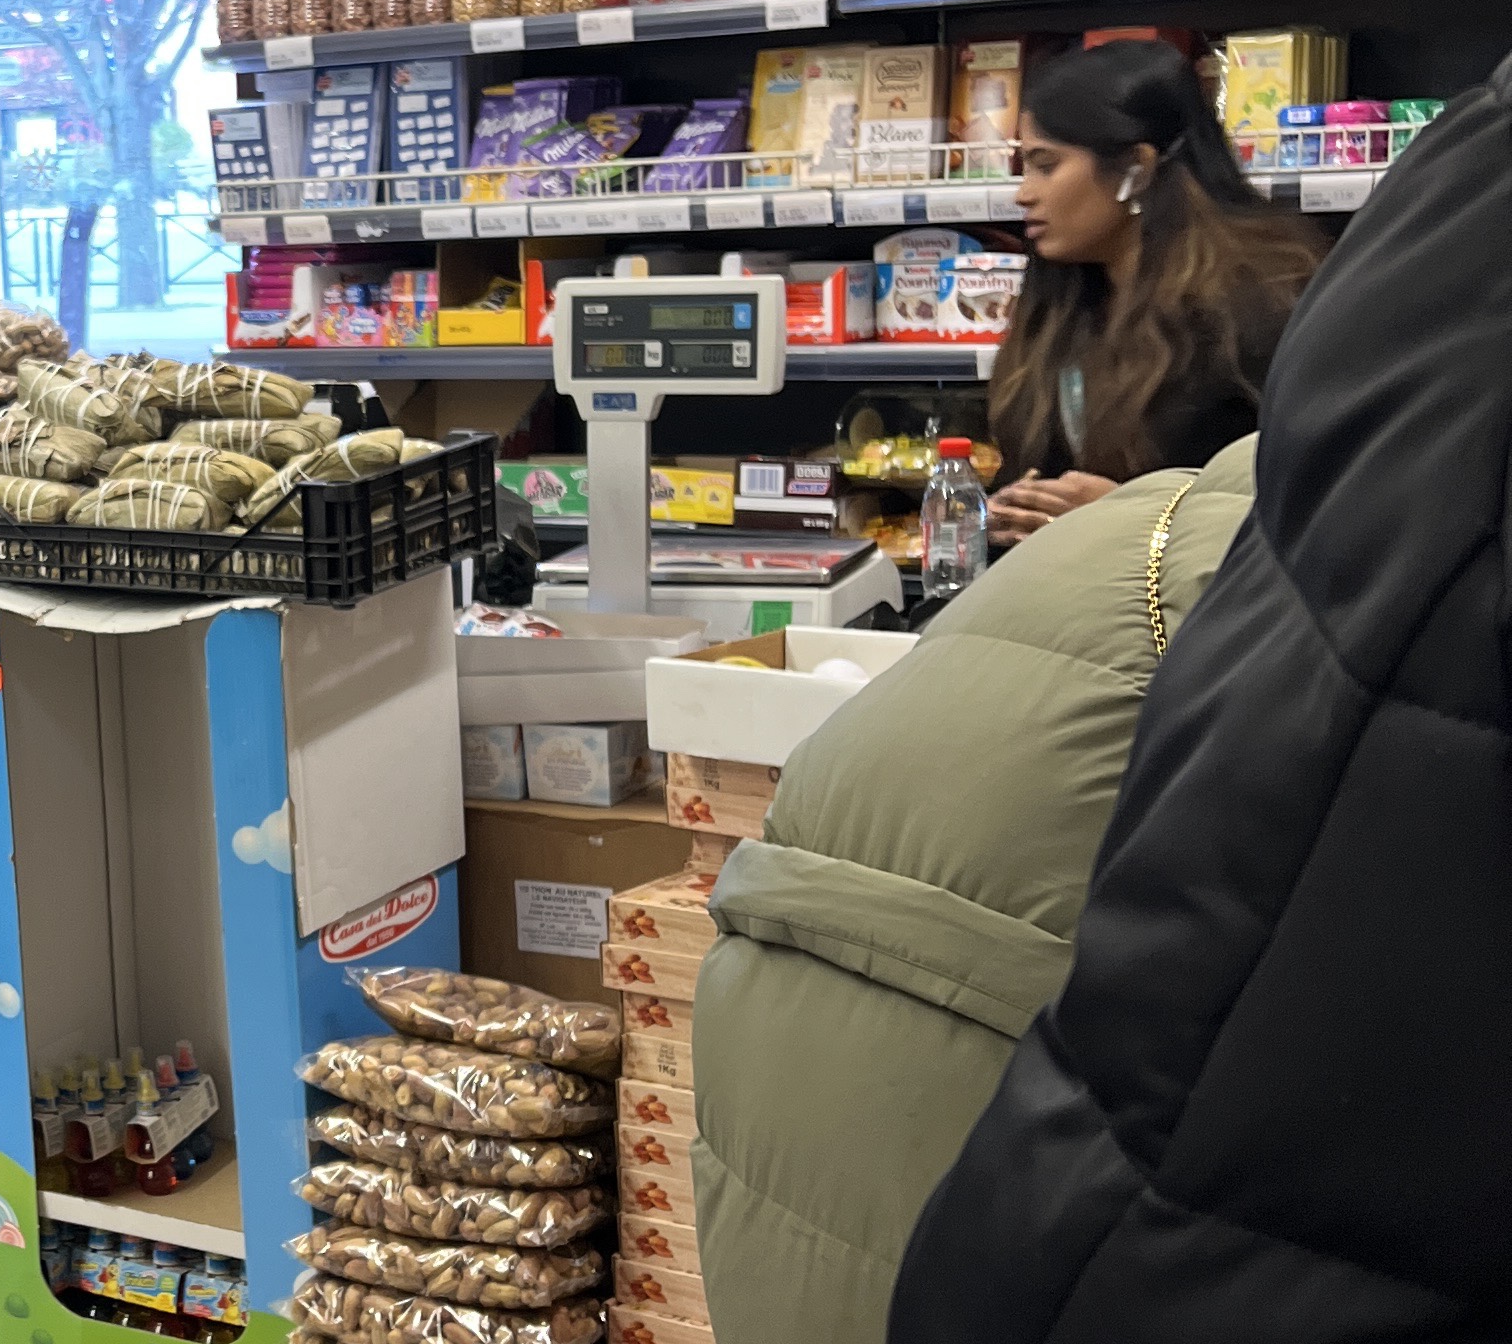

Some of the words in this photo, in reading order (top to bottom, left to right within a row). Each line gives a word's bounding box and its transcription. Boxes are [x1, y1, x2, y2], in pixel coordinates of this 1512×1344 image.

[542, 133, 587, 163] Milka
[957, 277, 1014, 293] Country
[384, 893, 429, 920] Dolce
[657, 1064, 677, 1077] 1Kg
